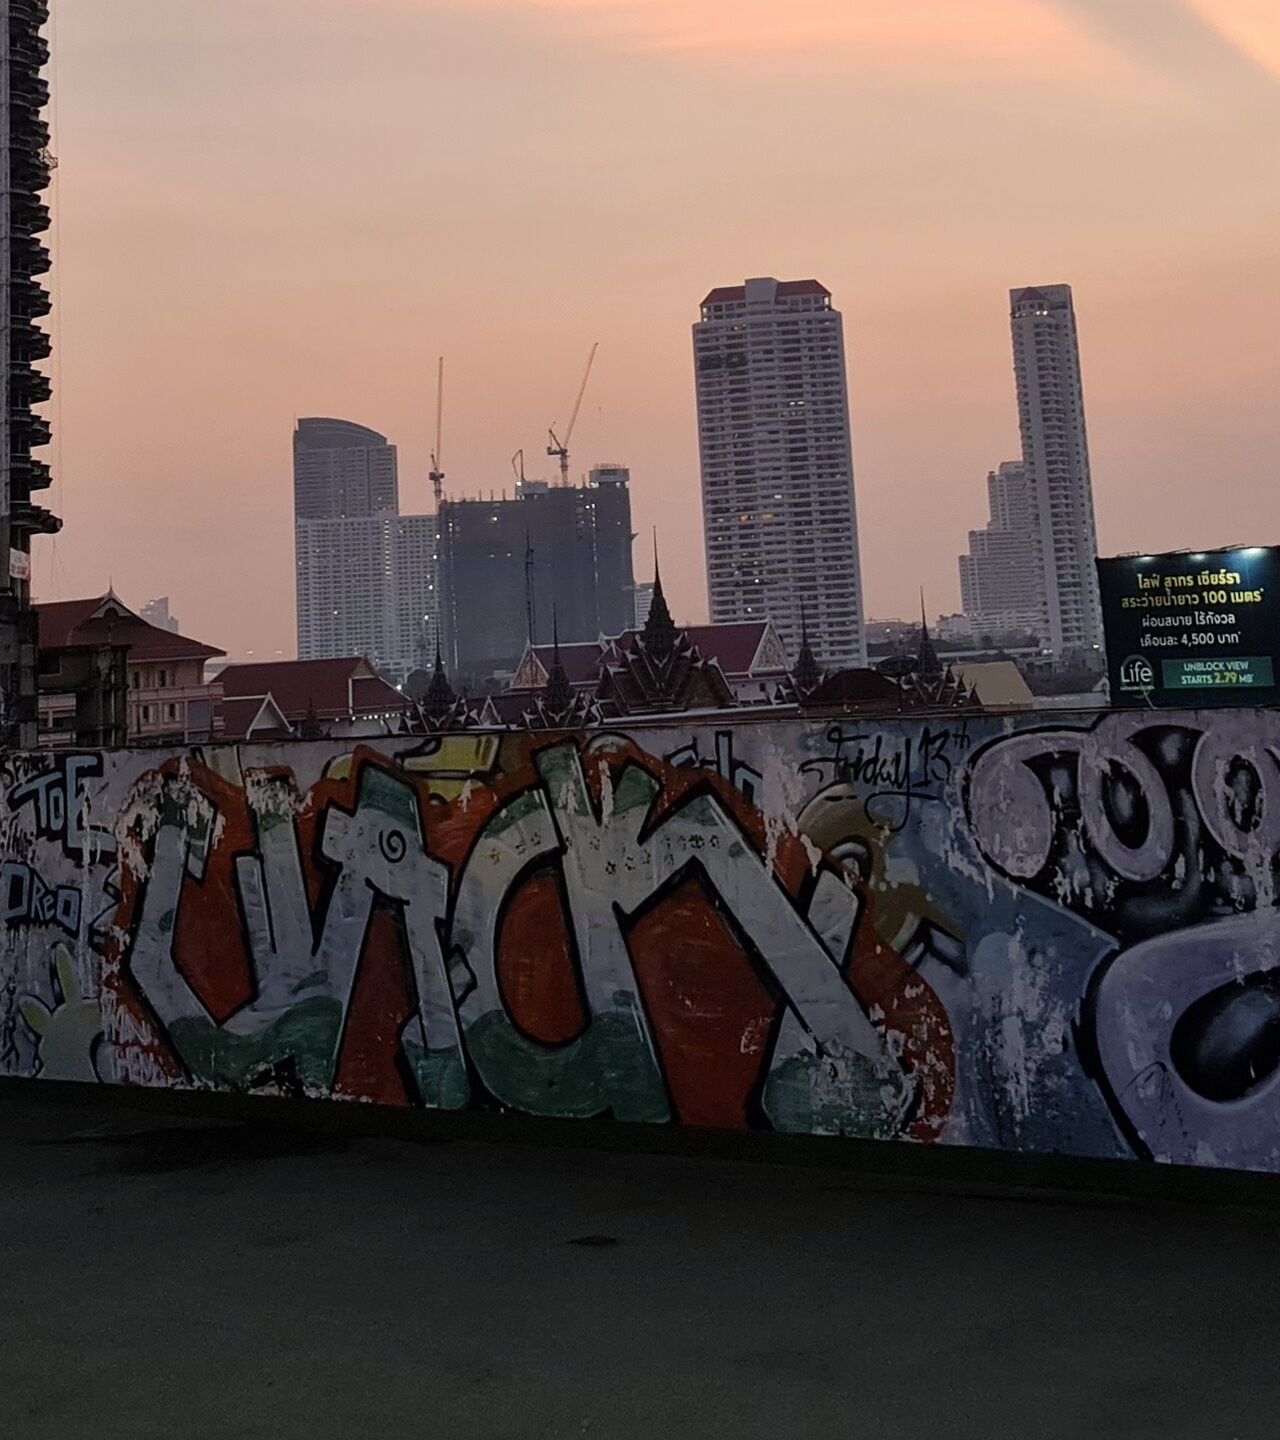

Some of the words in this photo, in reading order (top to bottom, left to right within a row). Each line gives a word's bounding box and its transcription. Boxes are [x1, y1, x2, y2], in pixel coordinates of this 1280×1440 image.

[1202, 590, 1227, 604] 100
[1181, 633, 1215, 647] 4,500
[1120, 661, 1153, 683] Life
[1183, 662, 1225, 672] UNBLOCK
[1226, 661, 1249, 671] VIEW
[1181, 675, 1213, 685] STARTS
[1214, 672, 1238, 684] 2.79
